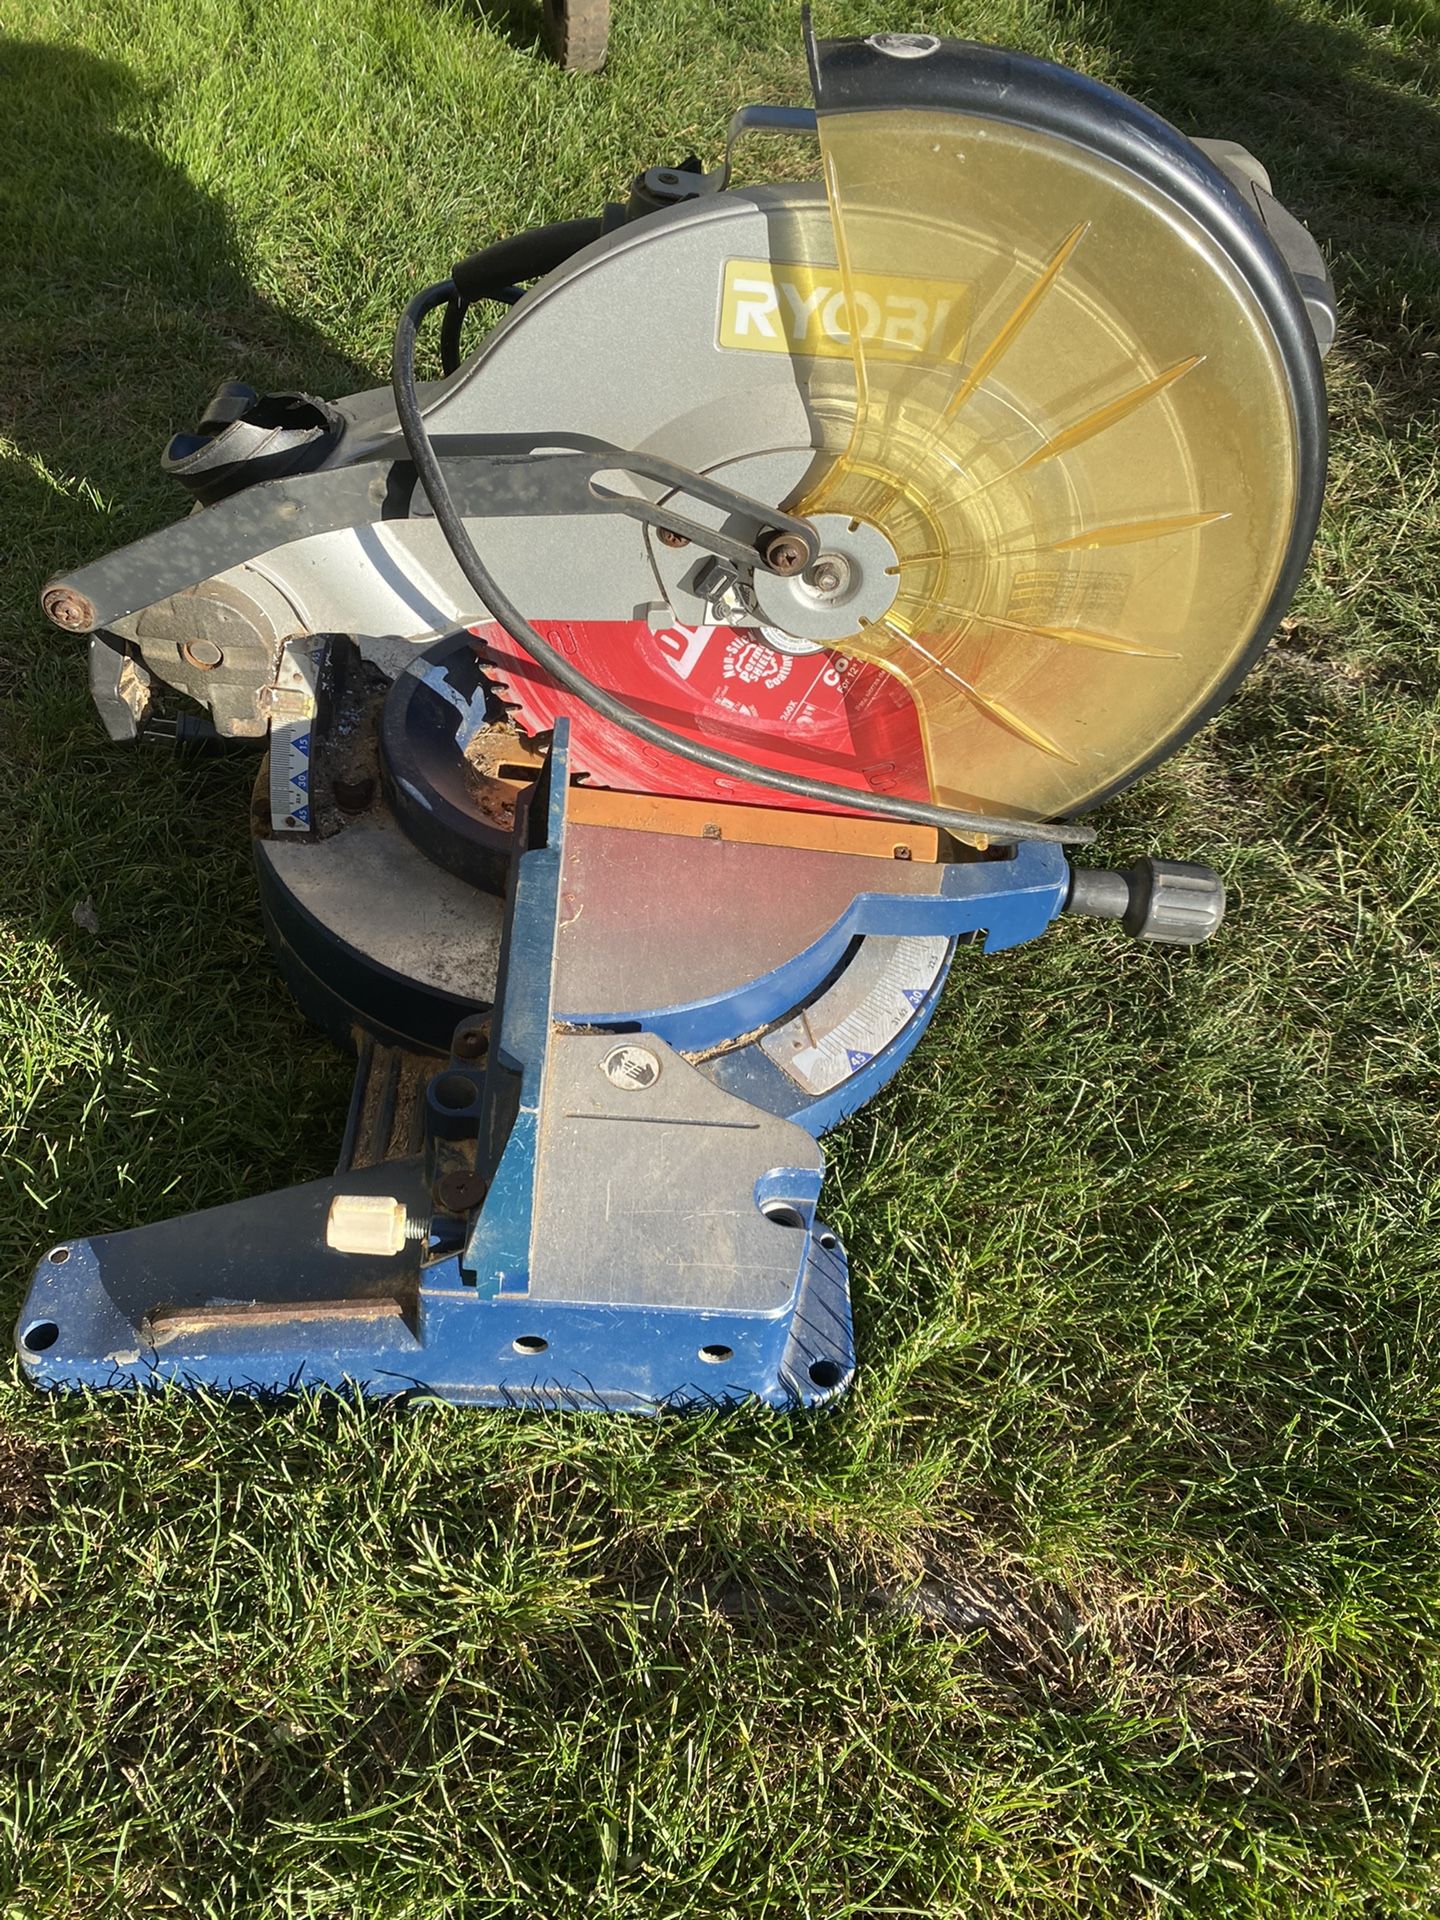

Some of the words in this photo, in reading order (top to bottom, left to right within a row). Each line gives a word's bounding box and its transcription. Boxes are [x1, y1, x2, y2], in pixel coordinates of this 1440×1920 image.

[732, 278, 950, 354] RYOBI
[836, 678, 851, 694] For
[300, 738, 308, 750] 15
[299, 775, 307, 787] 30
[299, 809, 307, 821] 45
[909, 990, 923, 1004] 30
[851, 1053, 867, 1066] 45
